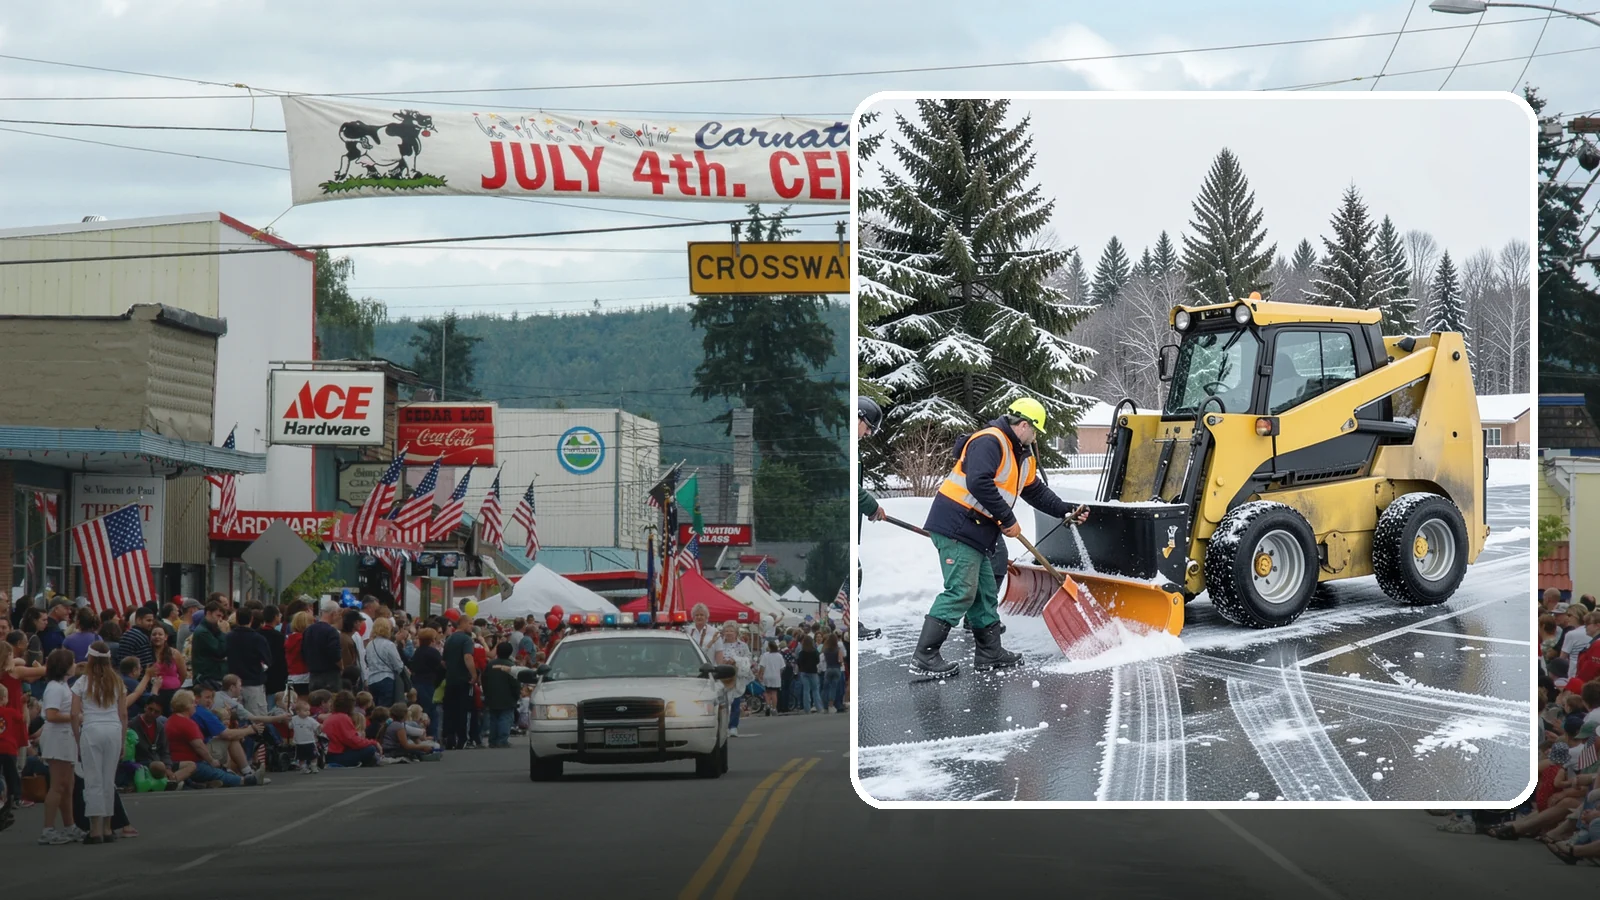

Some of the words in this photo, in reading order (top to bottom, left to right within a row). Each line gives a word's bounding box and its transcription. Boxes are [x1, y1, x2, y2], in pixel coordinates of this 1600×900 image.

[695, 122, 850, 149] Carnat
[481, 141, 605, 192] JULY
[633, 150, 746, 198] 4th.
[697, 254, 850, 280] CROSSWA
[283, 380, 374, 420] ACE
[405, 409, 452, 422] CEDAR
[283, 421, 371, 437] Hardware
[416, 428, 477, 447] Coca-Cola
[353, 467, 385, 479] Simpl
[95, 485, 124, 495] Vincent
[126, 485, 136, 495] de
[137, 485, 155, 495] Paul
[688, 526, 741, 535] CRNATION
[699, 535, 730, 543] GLASS
